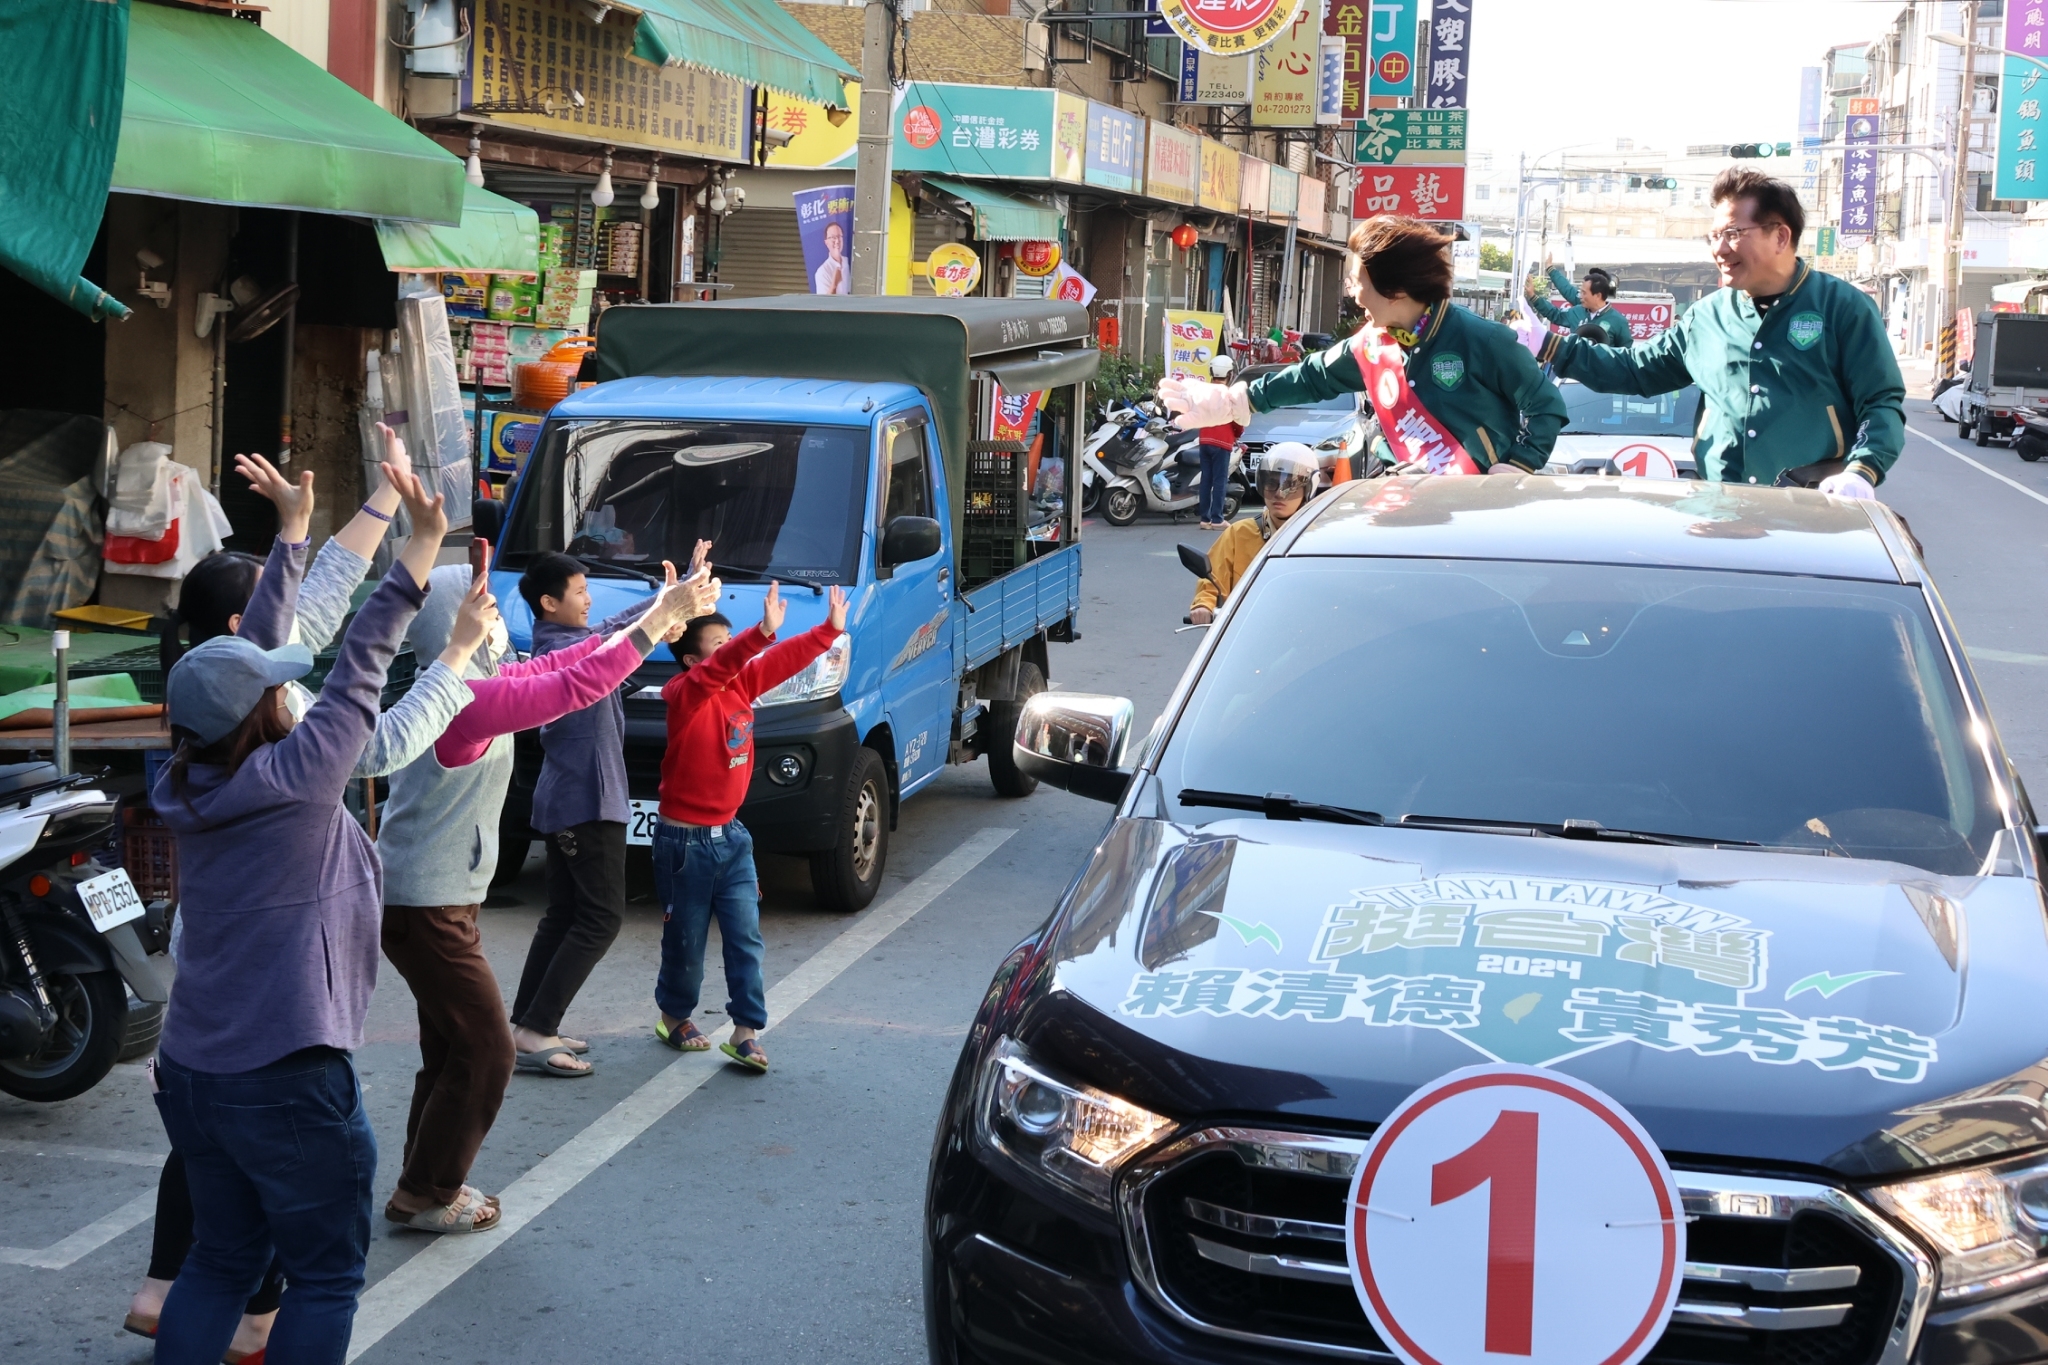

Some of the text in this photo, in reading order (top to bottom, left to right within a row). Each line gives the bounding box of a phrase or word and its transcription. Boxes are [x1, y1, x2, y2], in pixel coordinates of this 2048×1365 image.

[1253, 6, 1286, 40] 更精彩
[2023, 0, 2045, 49] 聰明
[1206, 33, 1245, 48] 看比賽
[1383, 57, 1405, 78] 中
[1198, 90, 1245, 99] 7223409
[1263, 92, 1304, 101] 預約專線
[1256, 104, 1312, 114] 04-7201273
[1406, 111, 1464, 122] 高山茶
[1851, 100, 1876, 114] 彰化
[1406, 125, 1464, 136] 烏龍茶
[2014, 67, 2043, 183] 沙鍋魚頭
[952, 125, 1040, 151] 台灣彩券
[1100, 114, 1132, 168] 富田行
[1358, 112, 1402, 161] 茶
[1405, 139, 1463, 149] 比賽茶
[1366, 172, 1449, 215] 品藝
[1849, 140, 1873, 227] 深海魚湯
[934, 265, 971, 282] 威力彩
[1654, 306, 1664, 322] 1
[1630, 323, 1666, 338] 秀芳
[1441, 371, 1457, 380] 2024
[787, 569, 839, 578] VERYCA
[1362, 878, 1758, 936] TEAM TAIWAN
[1319, 900, 1766, 992] 挺台灣
[1476, 953, 1582, 981] 2024
[1120, 968, 1938, 1085] 賴清德 黃秀芳
[1430, 1109, 1540, 1357] 1
